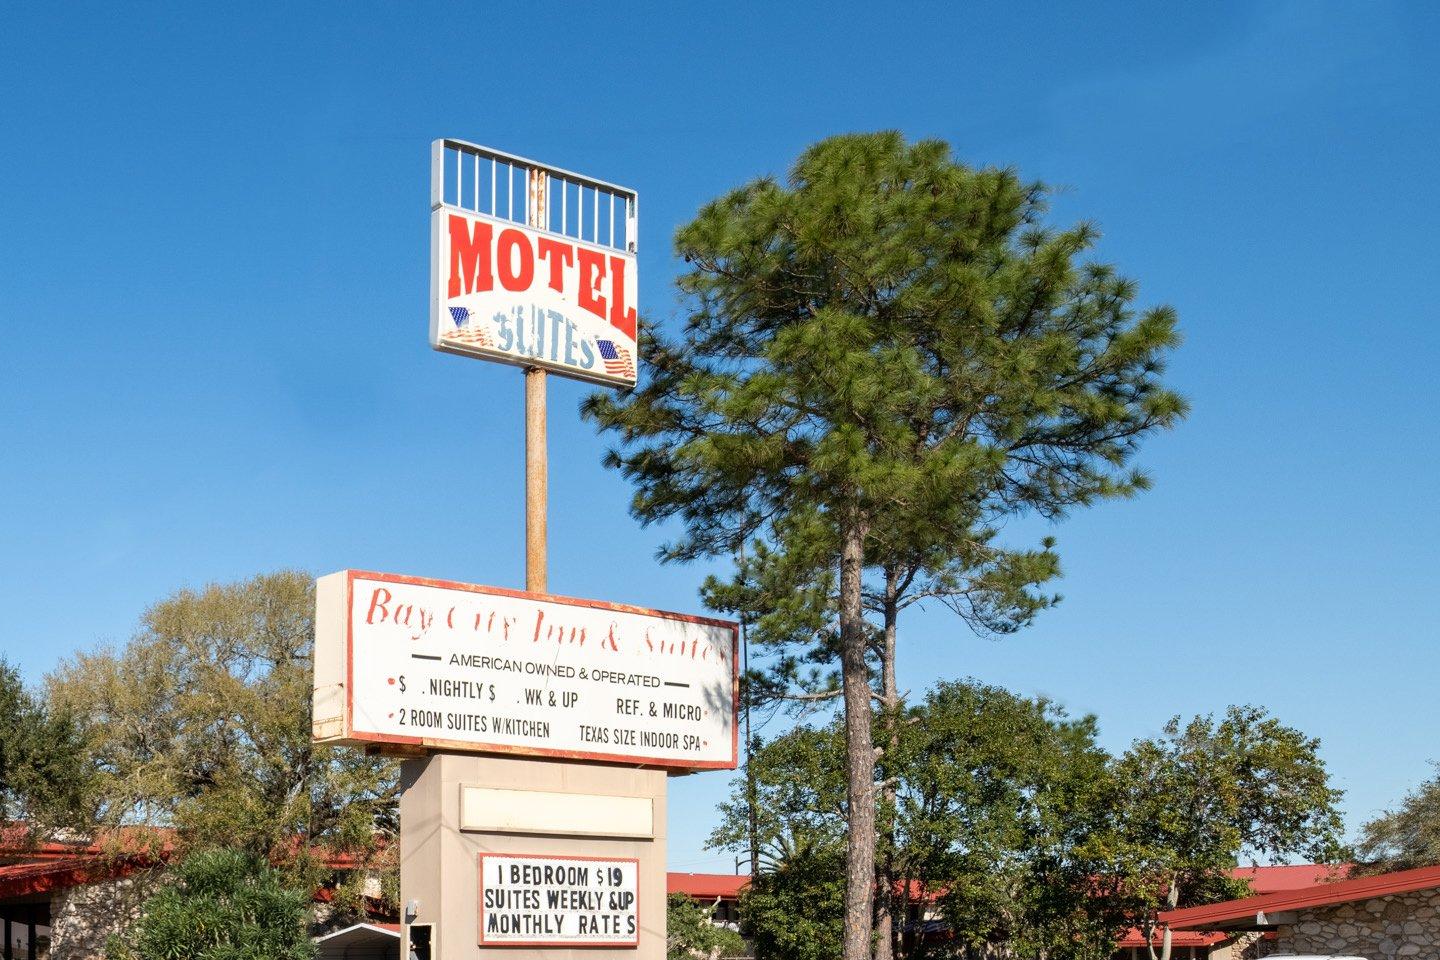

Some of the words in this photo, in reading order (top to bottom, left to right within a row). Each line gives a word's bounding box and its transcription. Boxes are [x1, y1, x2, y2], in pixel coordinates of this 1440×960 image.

[448, 213, 636, 343] MOTEL
[492, 304, 595, 370] SUITES
[449, 653, 522, 673] AMERICAN
[525, 662, 575, 679] OWNED
[578, 668, 589, 680] &
[591, 669, 660, 688] OPERATED
[429, 678, 484, 700] NIGHTLY
[525, 688, 543, 707] WK
[548, 690, 557, 708] &
[562, 691, 579, 709] UP
[399, 708, 406, 726] 2
[411, 709, 443, 729] ROOM
[447, 713, 488, 733] SUITES
[492, 716, 550, 739] W/KITCHEN
[616, 698, 643, 717] REF.
[648, 701, 658, 718] &
[663, 702, 702, 722] MICRO
[579, 725, 609, 744] TEXAS
[613, 728, 636, 746] SIZE
[640, 731, 679, 750] INDOOR
[683, 734, 701, 752] SPA
[510, 864, 588, 886] BEDROOM
[485, 888, 540, 909] SUITES
[547, 890, 603, 910] WEEKLY
[487, 912, 565, 934] MONTHLY
[578, 914, 636, 935] RATES
